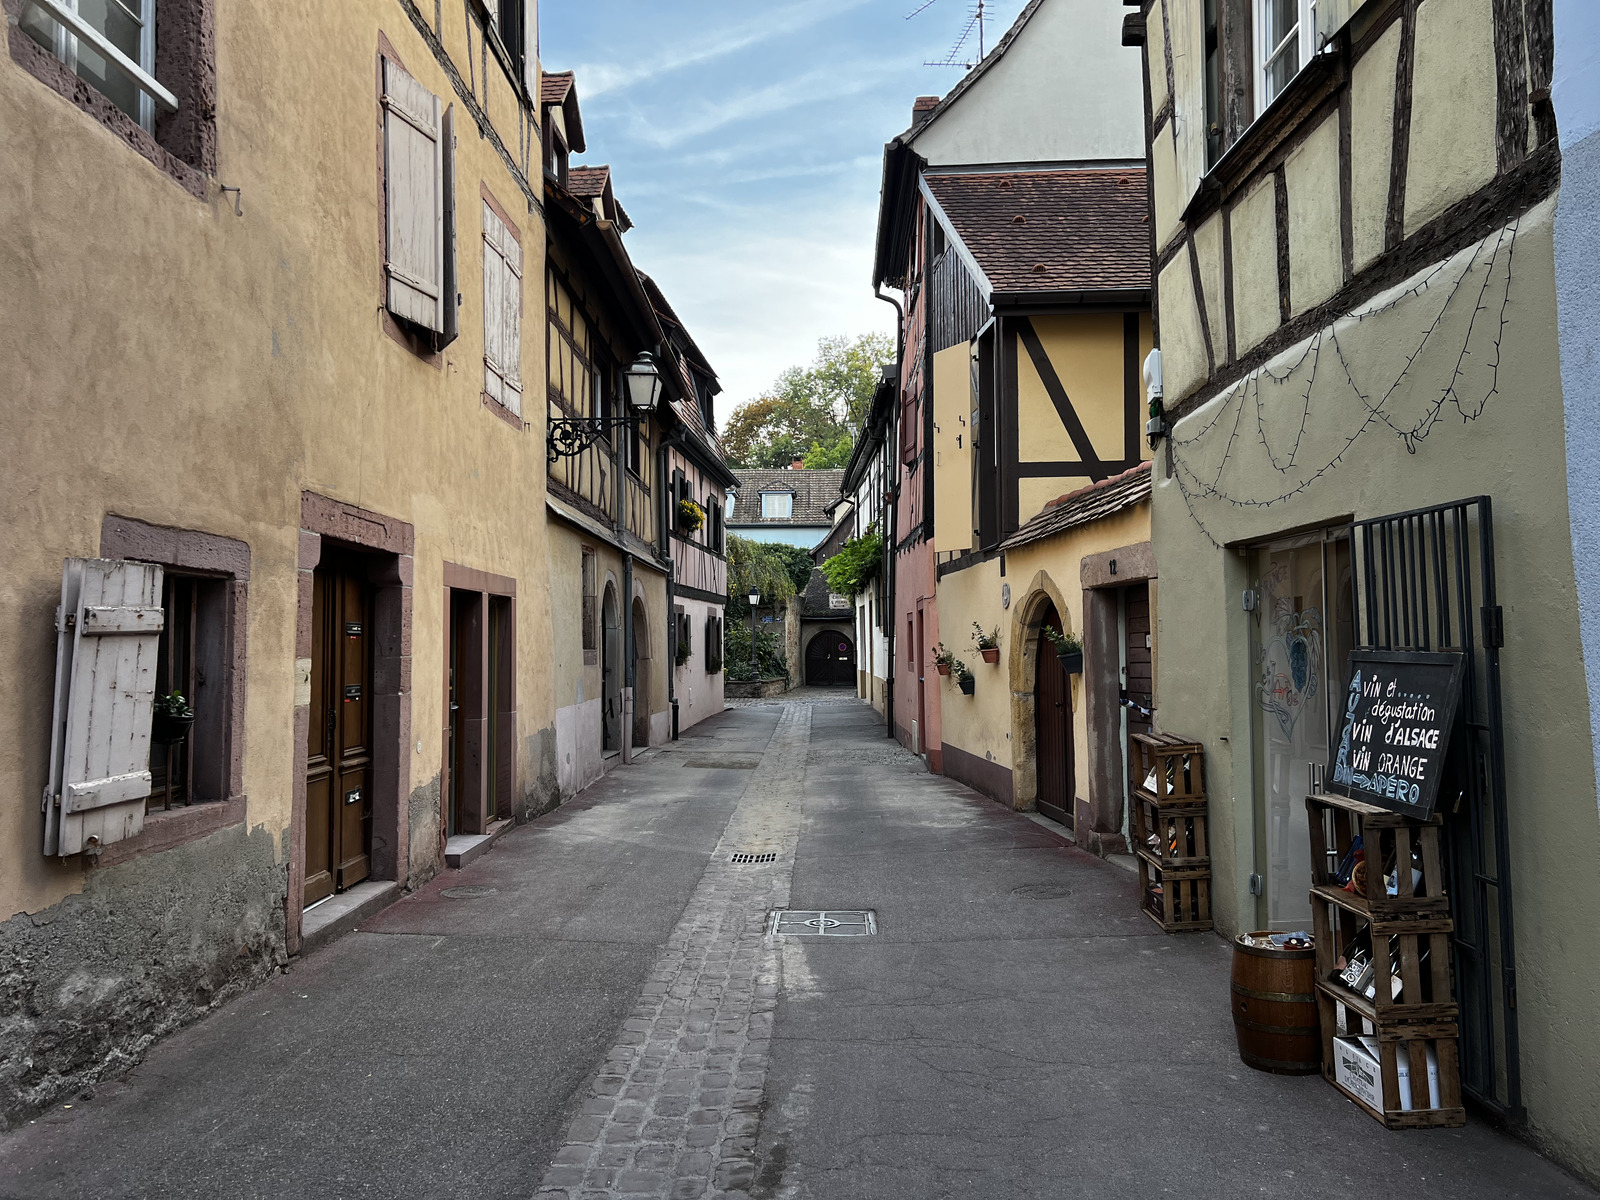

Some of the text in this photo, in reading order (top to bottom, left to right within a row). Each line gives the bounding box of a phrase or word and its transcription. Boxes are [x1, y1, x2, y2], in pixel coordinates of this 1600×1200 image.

[1109, 559, 1117, 575] 12
[1371, 699, 1435, 725] dégustation
[1384, 719, 1440, 749] d'ALSACE
[1377, 753, 1428, 780] ORANGE
[1368, 773, 1420, 804] APÉRO
